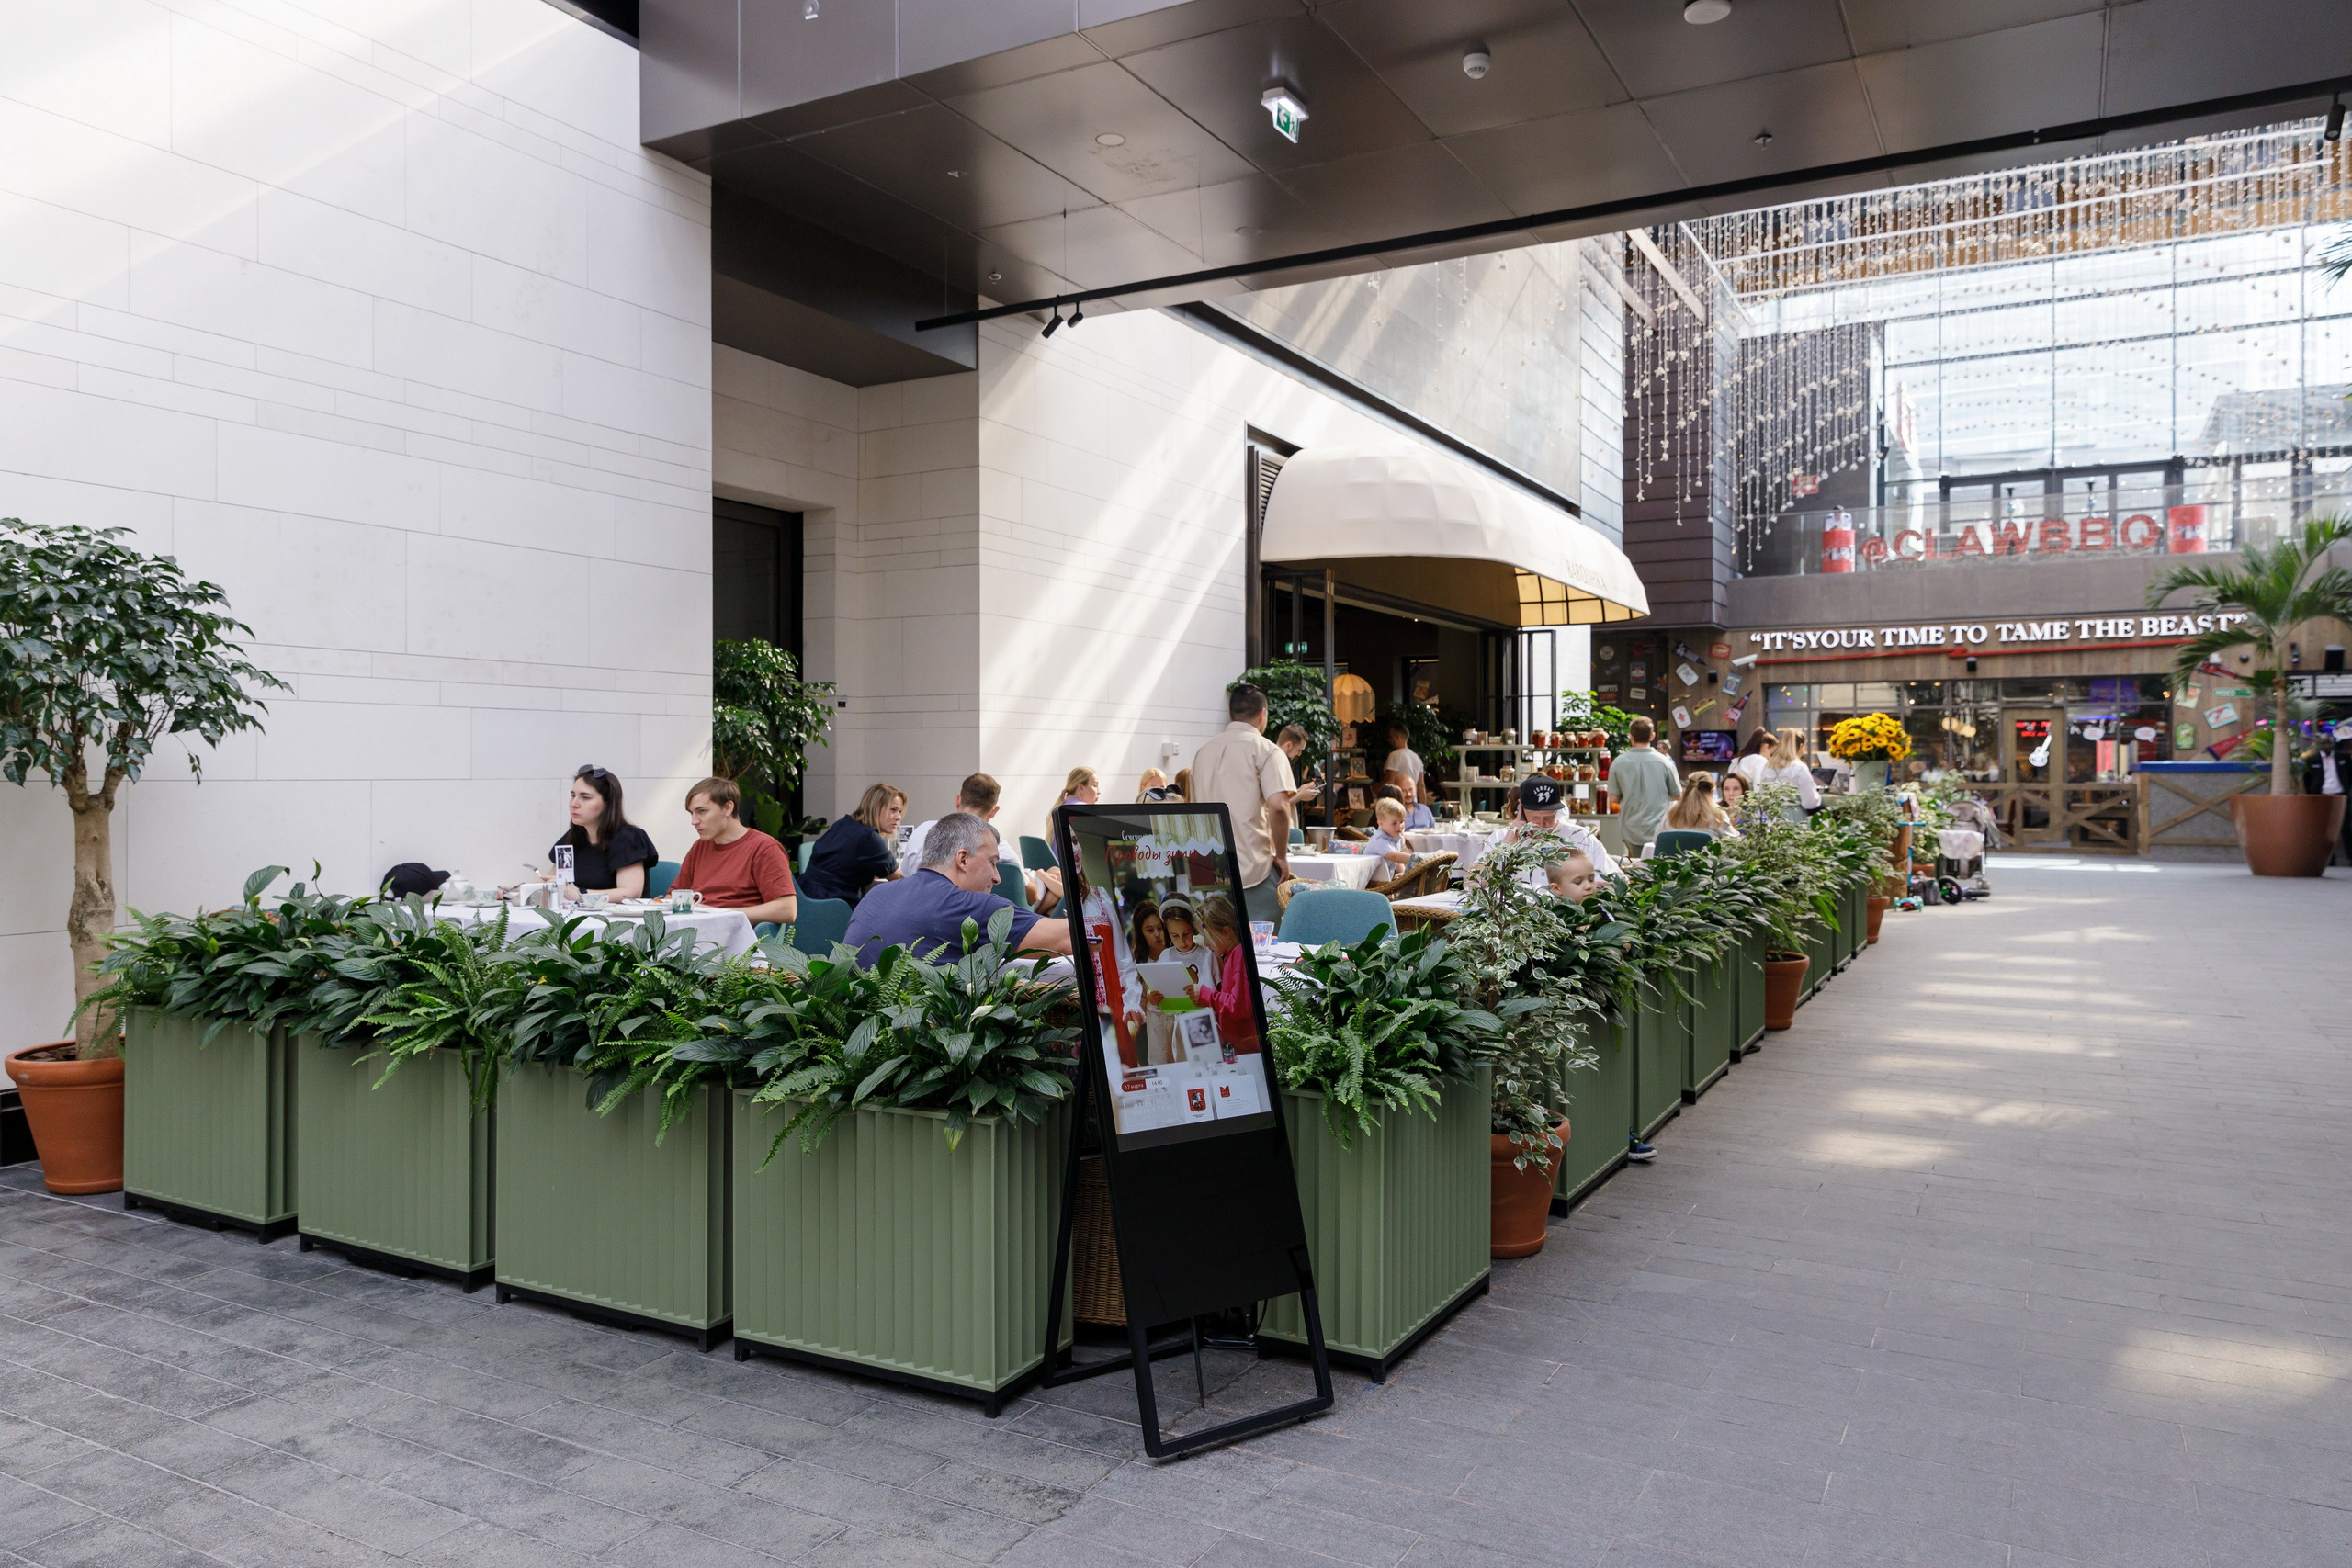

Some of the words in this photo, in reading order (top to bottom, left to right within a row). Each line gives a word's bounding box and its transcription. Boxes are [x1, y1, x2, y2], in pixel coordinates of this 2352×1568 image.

[1880, 626, 1946, 646] TIME
[1949, 625, 1988, 644] TO
[1995, 621, 2071, 642] TAME
[2075, 618, 2136, 639] THE
[1105, 844, 1161, 868] Проводы
